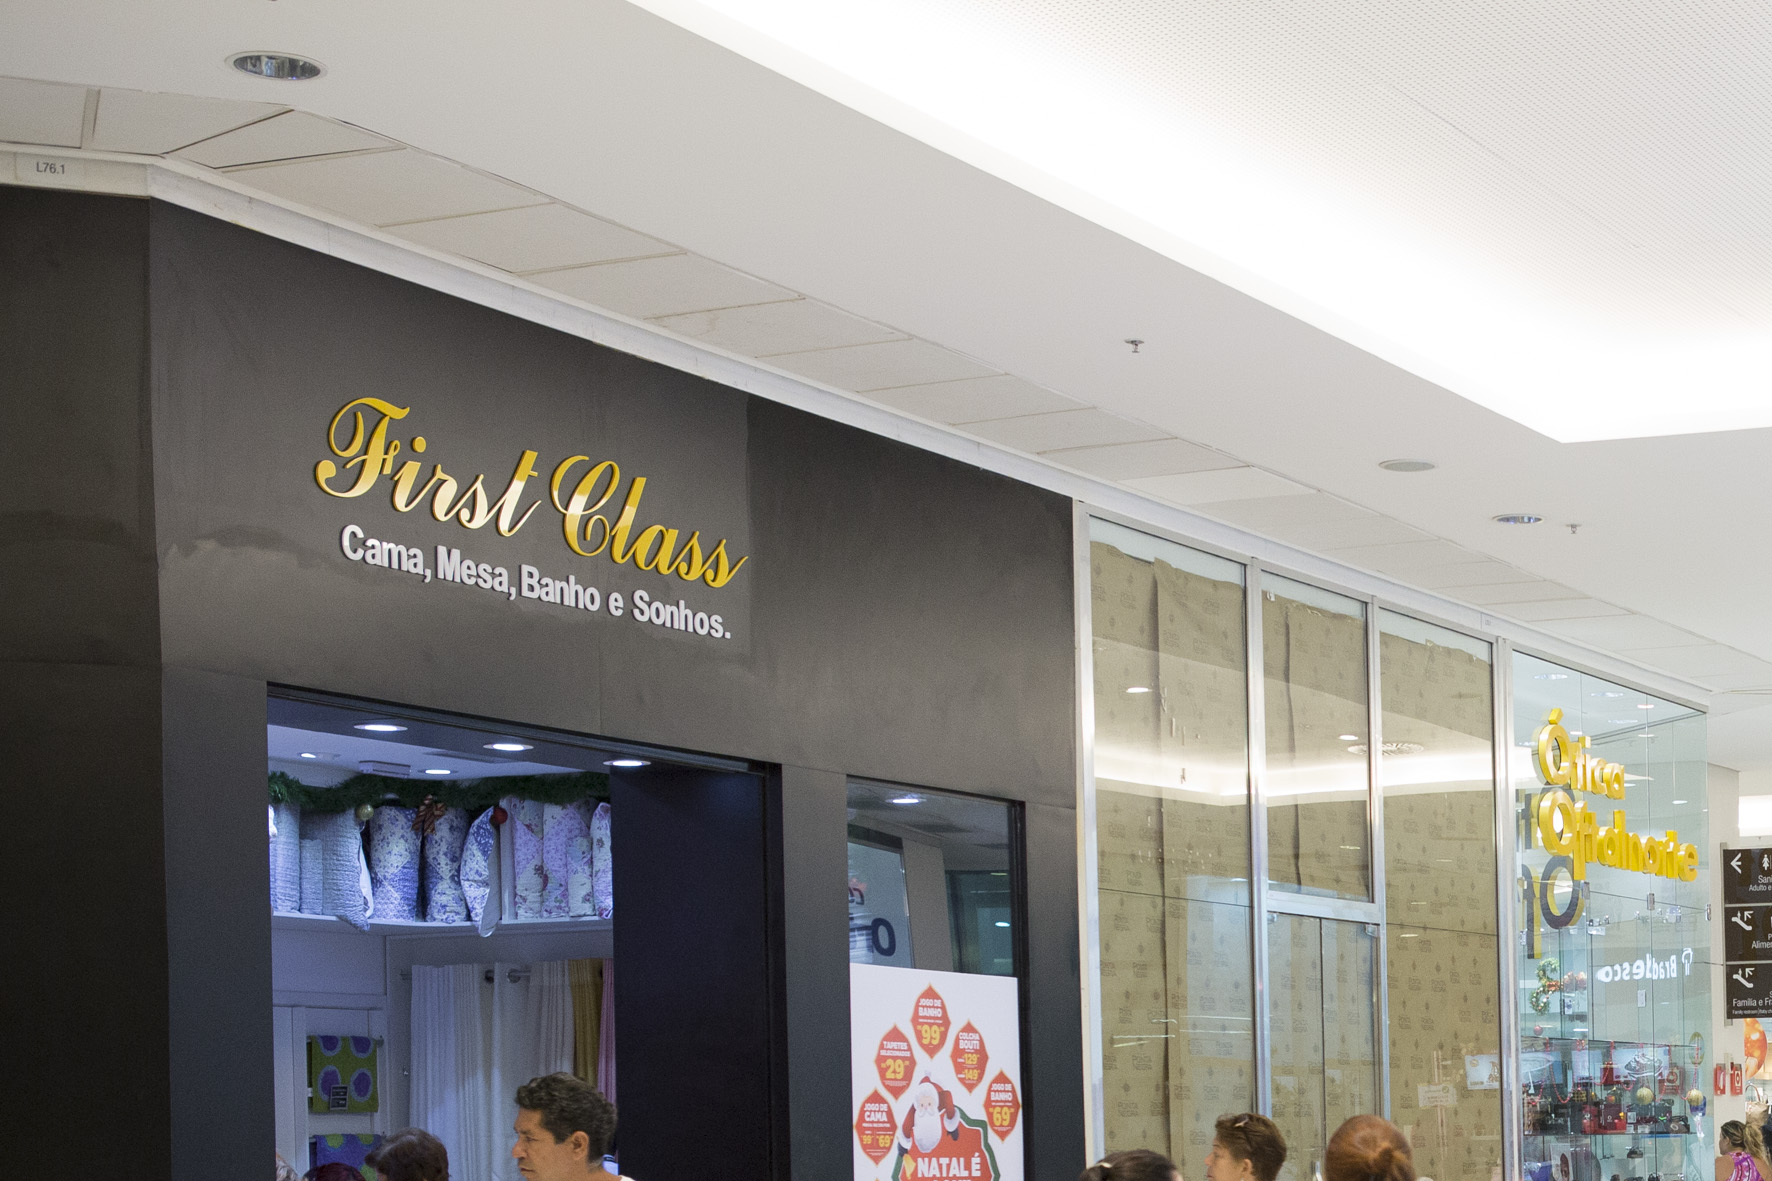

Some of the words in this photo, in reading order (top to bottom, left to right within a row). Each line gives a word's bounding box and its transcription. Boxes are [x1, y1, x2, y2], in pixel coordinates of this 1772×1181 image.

[36, 161, 65, 175] L76.1
[315, 397, 542, 537] First
[551, 455, 749, 588] Class
[341, 524, 431, 582] Cama,
[437, 545, 516, 600] Mesa,
[521, 564, 600, 611] Banho
[608, 590, 623, 616] e
[632, 589, 731, 639] Sonhos.
[1538, 707, 1626, 801] Ótica
[1539, 790, 1698, 881] Oftalnorte
[1748, 884, 1767, 892] Adulto
[919, 998, 934, 1007] JOGO
[934, 999, 942, 1007] DE
[1733, 998, 1757, 1008] Família
[918, 1007, 943, 1018] BANHO
[959, 1032, 980, 1041] COLCHA
[883, 1041, 908, 1050] TAPETES
[959, 1039, 980, 1050] BOUTI
[991, 1083, 1004, 1091] JOGO
[1004, 1083, 1012, 1091] DE
[991, 1091, 1013, 1101] BANHO
[864, 1103, 879, 1111] JOGO
[879, 1103, 888, 1111] DE
[864, 1111, 888, 1122] CAMA
[917, 1157, 969, 1178] NATAL
[971, 1152, 981, 1177] É
